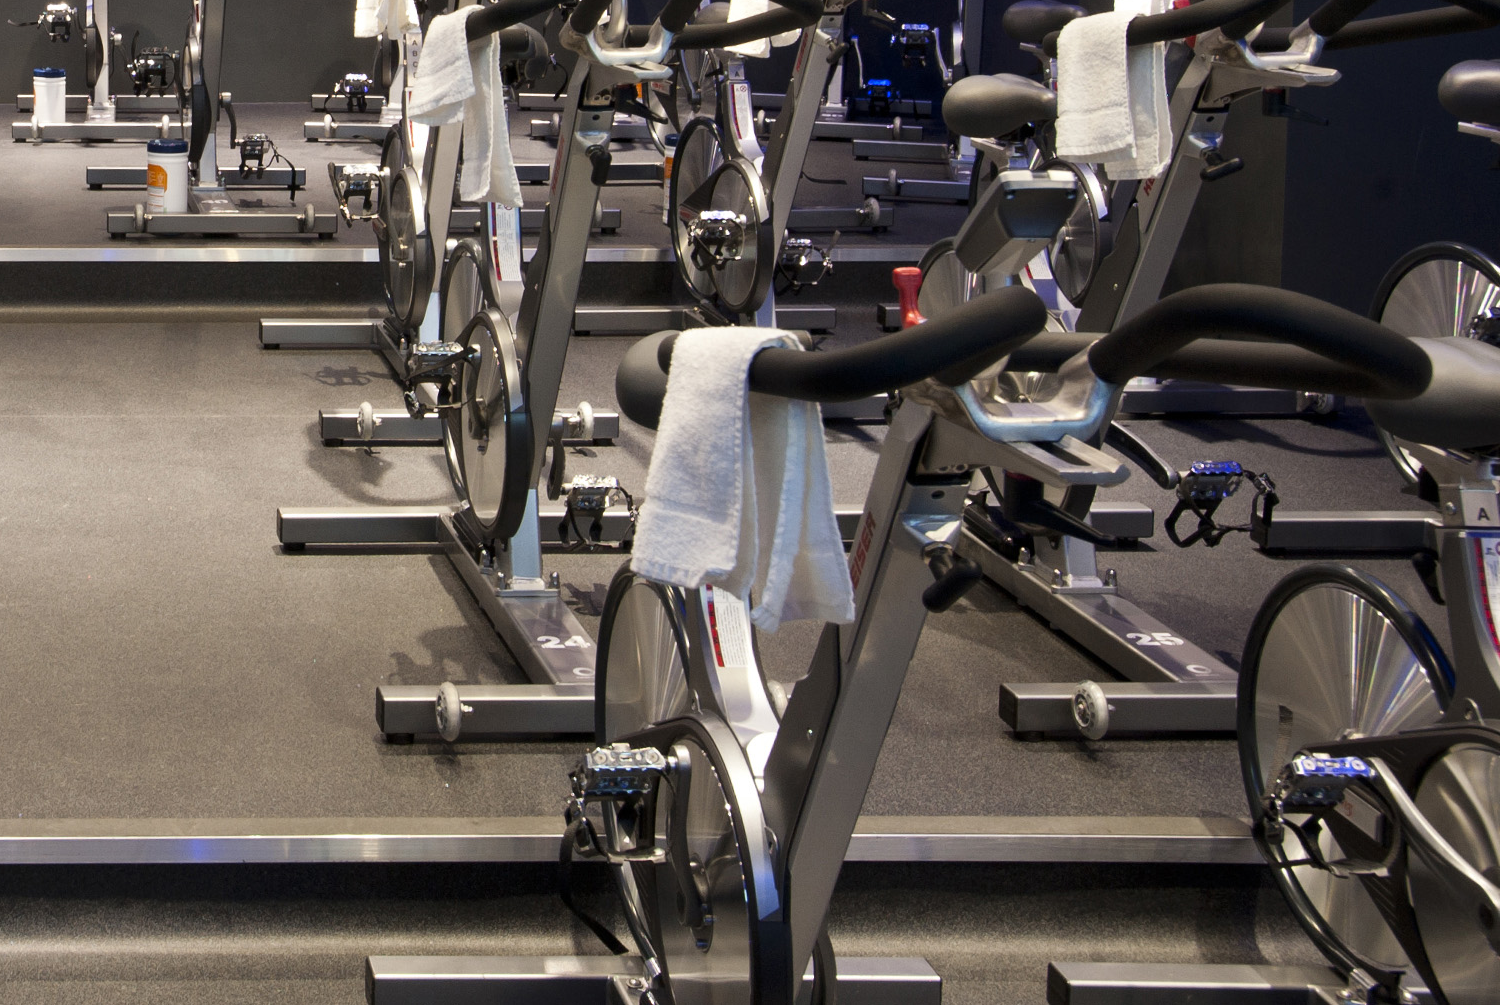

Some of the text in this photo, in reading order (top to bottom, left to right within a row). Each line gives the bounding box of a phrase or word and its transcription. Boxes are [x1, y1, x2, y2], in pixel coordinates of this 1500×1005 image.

[1477, 507, 1490, 521] A
[850, 510, 876, 591] EISER
[537, 635, 591, 649] 24
[1126, 632, 1184, 646] 25
